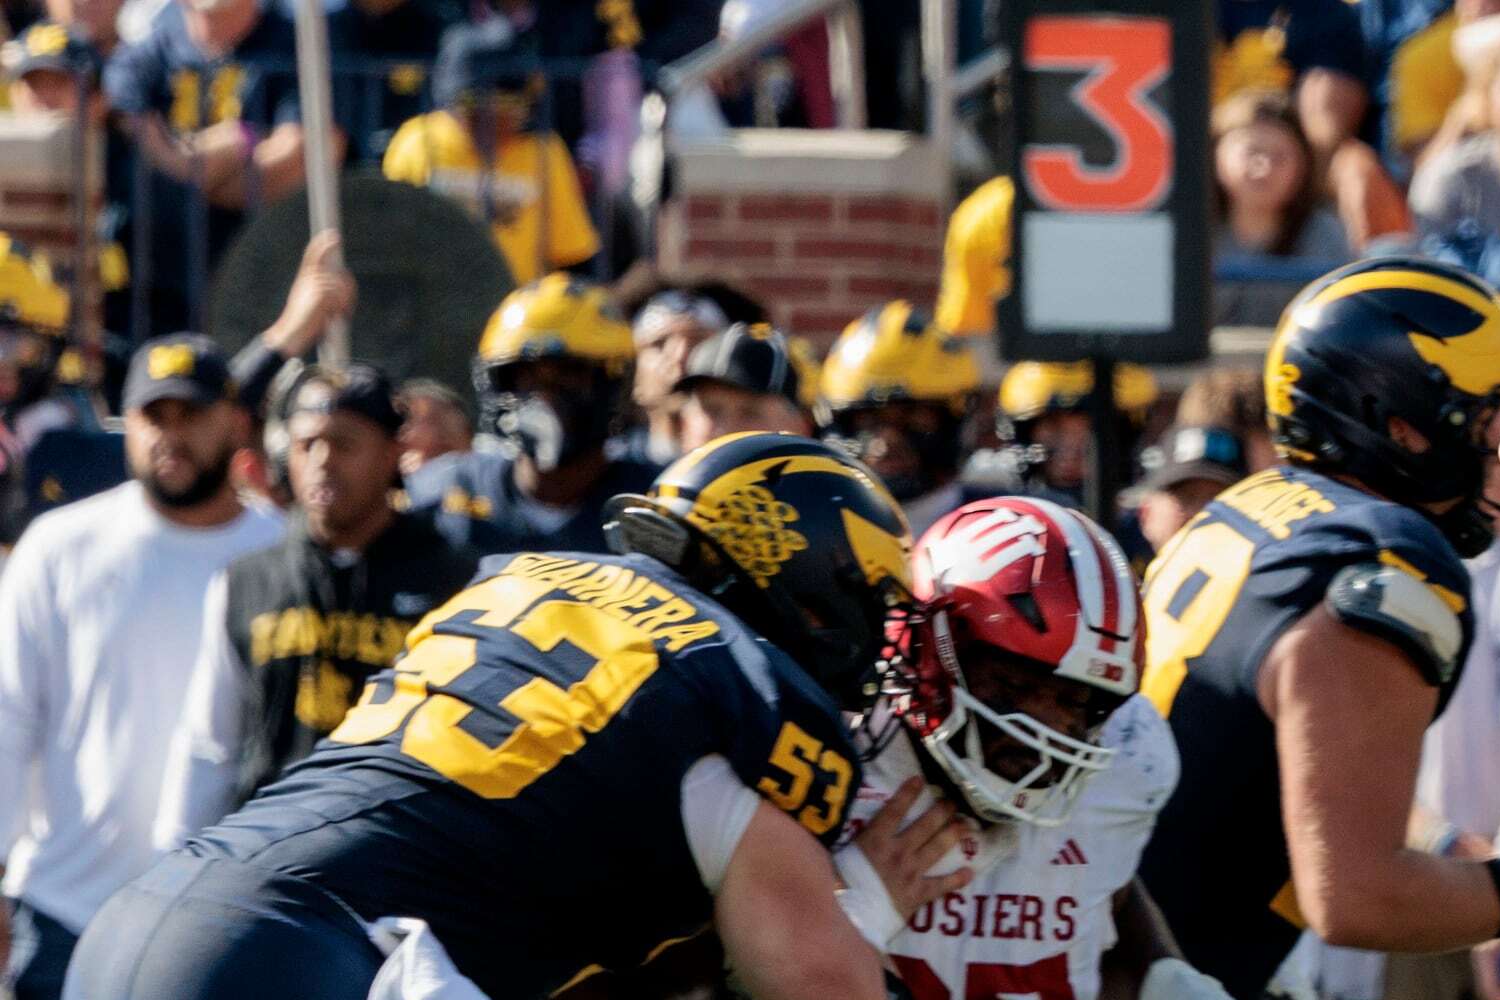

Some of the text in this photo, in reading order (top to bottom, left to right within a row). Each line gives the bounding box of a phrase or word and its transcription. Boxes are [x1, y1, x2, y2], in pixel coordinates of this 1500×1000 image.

[1022, 16, 1172, 214] 3
[327, 573, 660, 799] 53
[756, 720, 854, 836] 53
[908, 891, 1080, 941] OSIERS
